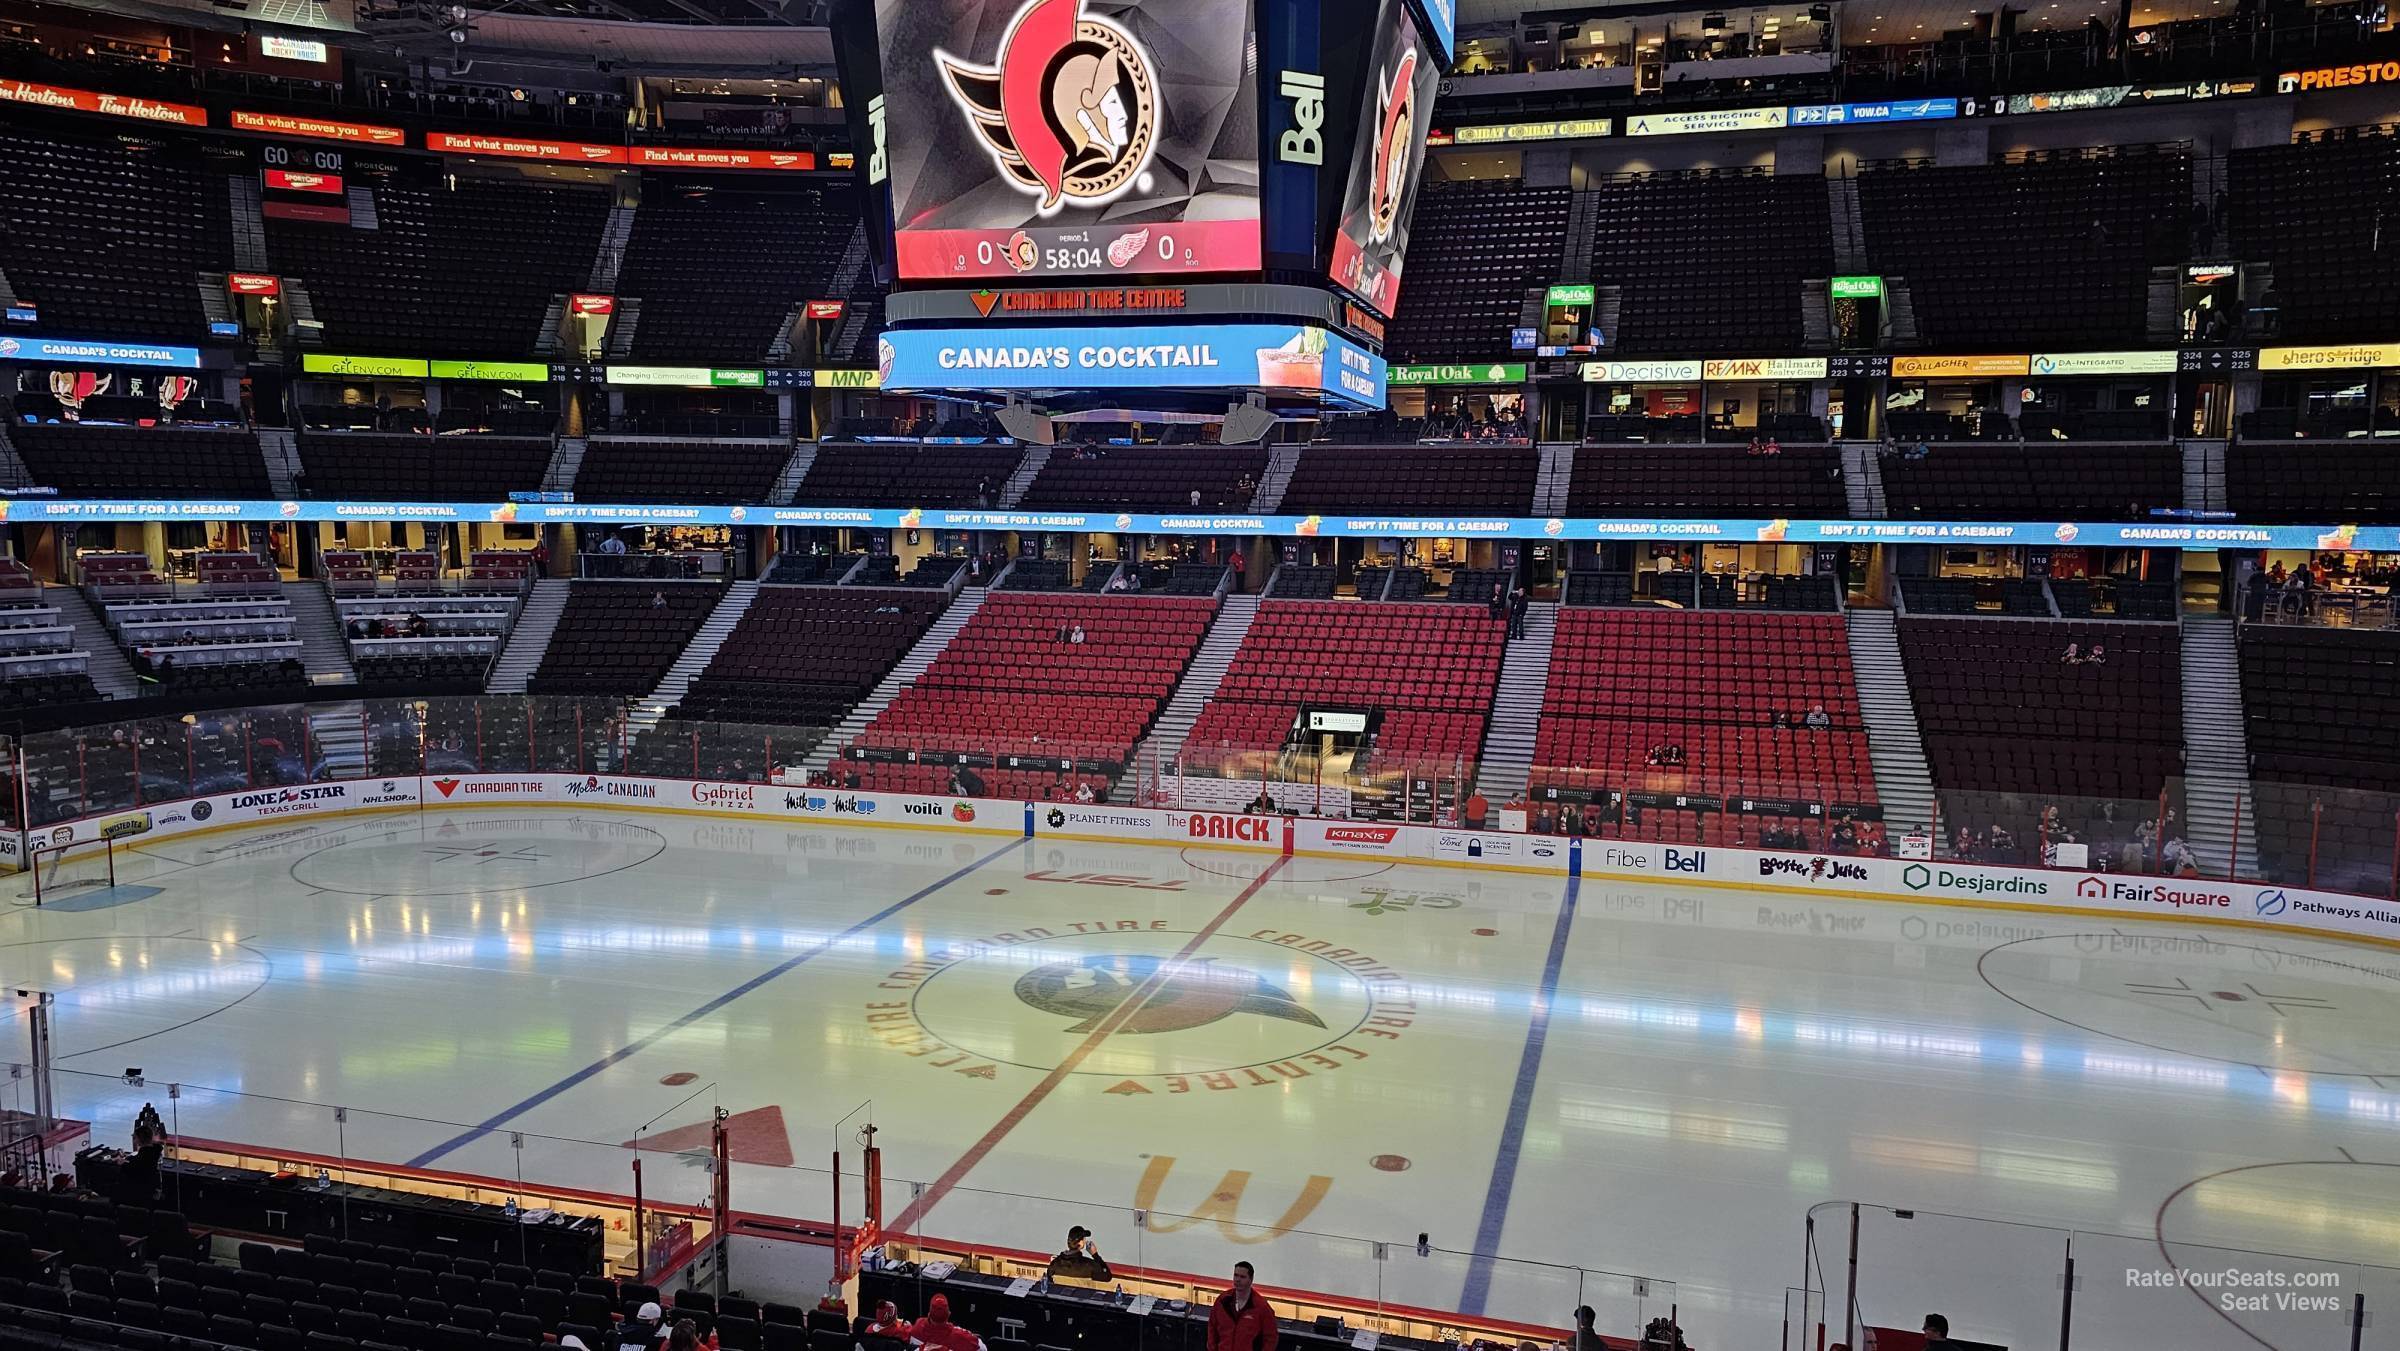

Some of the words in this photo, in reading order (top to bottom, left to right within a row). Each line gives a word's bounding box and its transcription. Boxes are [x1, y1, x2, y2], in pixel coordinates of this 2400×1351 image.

[15, 83, 77, 107] Hortons
[97, 95, 127, 116] Tim
[128, 100, 187, 122] Hortons
[1852, 106, 1890, 118] YOW.CA
[1965, 101, 1976, 115] 0
[1994, 100, 2005, 114] 0
[1281, 70, 1325, 166] Bell
[1663, 114, 1706, 123] ACCESS
[1710, 111, 1761, 121] RIGGING
[236, 114, 263, 127] Find
[266, 116, 298, 129] what
[299, 121, 336, 134] moves
[338, 124, 360, 138] you
[1457, 126, 1505, 141] COMBAT
[1507, 124, 1557, 138] COMBAT
[1558, 121, 1609, 136] COMBAT
[1684, 120, 1738, 130] SERVICES
[445, 136, 471, 148] Find
[473, 138, 501, 149] what
[503, 142, 536, 152] moves
[539, 143, 560, 156] you
[869, 94, 887, 185] Bell
[264, 146, 288, 164] GO
[315, 151, 342, 170] GO!
[644, 151, 669, 161] Find
[671, 151, 696, 162] what
[697, 153, 729, 163] moves
[731, 154, 749, 165] you
[978, 241, 992, 265] 0
[1158, 235, 1174, 260] 0
[1185, 248, 1192, 259] 0
[958, 255, 965, 265] 0
[1045, 247, 1102, 270] 58:04
[1003, 290, 1086, 310] CANADIAN
[1087, 289, 1124, 310] TIRE
[1126, 288, 1186, 309] CENTRE
[1573, 289, 1591, 299] Oak
[42, 344, 107, 357] CANADA'S
[109, 346, 173, 360] COCKTAIL
[938, 345, 1070, 370] CANADA'S
[1077, 344, 1219, 369] COCKTAIL
[2183, 351, 2202, 360] 324
[2231, 350, 2251, 359] 325
[1767, 359, 1823, 370] Hallmark
[1831, 358, 1849, 366] 323
[1871, 357, 1888, 365] 324
[1907, 359, 1969, 372] GALLAGHER
[2058, 359, 2125, 367] DA-INTEGRATED
[2183, 362, 2201, 370] 224
[2231, 360, 2250, 369] 225
[616, 371, 651, 380] Changing
[652, 372, 699, 380] Communities
[1396, 366, 1438, 384] Royal
[1441, 365, 1473, 380] Oak
[1610, 363, 1692, 380] Decisive
[1706, 361, 1763, 377] RE/MAX
[1767, 369, 1796, 378] Realty
[1797, 368, 1824, 377] Group
[1831, 369, 1848, 377] 223
[1870, 369, 1887, 377] 224
[552, 374, 566, 382] 218
[798, 379, 811, 387] 220
[831, 371, 873, 386] MNP
[46, 504, 76, 515] ISN'T
[85, 505, 98, 515] IT
[103, 505, 135, 515] TIME
[138, 505, 162, 515] FOR
[165, 505, 179, 515] A
[185, 505, 241, 516] CAESAR?
[337, 505, 398, 516] CANADA'S
[400, 506, 457, 516] COCKTAIL
[545, 507, 573, 517] ISN'T
[577, 508, 588, 517] IT
[591, 508, 616, 517] TIME
[618, 508, 639, 518] FOR
[640, 509, 652, 518] A
[654, 509, 700, 518] CAESAR?
[774, 511, 821, 520] CANADA'S
[824, 512, 872, 521] COCKTAIL
[945, 515, 970, 524] ISN'T
[972, 515, 983, 524] IT
[984, 515, 1009, 525] TIME
[1011, 516, 1030, 525] FOR
[1031, 516, 1039, 525] A
[1041, 516, 1085, 526] CAESAR?
[1161, 519, 1211, 528] CANADA'S
[1213, 520, 1264, 529] COCKTAIL
[1347, 521, 1375, 530] ISN'T
[1378, 522, 1389, 531] IT
[1391, 522, 1418, 531] TIME
[1421, 522, 1446, 531] FOR
[1447, 522, 1455, 531] A
[1457, 522, 1510, 532] CAESAR?
[1598, 524, 1658, 534] CANADA'S
[1660, 524, 1721, 534] COCKTAIL
[1820, 525, 1855, 535] ISN'T
[1857, 526, 1870, 536] IT
[1874, 526, 1906, 536] TIME
[1908, 526, 1935, 536] FOR
[1939, 526, 1949, 536] A
[1952, 526, 2014, 537] CAESAR?
[2120, 528, 2192, 541] CANADA'S
[2195, 529, 2271, 541] COCKTAIL
[2031, 556, 2047, 564] 118
[464, 782, 520, 794] CANADIAN
[521, 782, 544, 793] TIRE
[565, 776, 604, 797] Molson
[607, 782, 656, 799] CANADIAN
[692, 783, 754, 803] Gabriel
[231, 791, 277, 809] LONE
[300, 785, 346, 800] STAR
[711, 799, 754, 809] PIZZA
[257, 804, 290, 815] TEXAS
[292, 802, 319, 812] GRILL
[904, 801, 943, 816] voilà
[1069, 813, 1108, 825] PLANET
[1110, 815, 1151, 827] FITNESS
[104, 821, 130, 836] TWISTED
[131, 821, 143, 830] TEA
[1165, 813, 1187, 828] The
[1189, 813, 1271, 842] BRICK
[1440, 836, 1463, 848] Ford
[1606, 849, 1647, 868] Fibe
[1664, 849, 1705, 873] Bell
[1759, 857, 1810, 877] Booster
[1826, 861, 1868, 881] Juice
[1938, 871, 2048, 895] Desjardins
[2113, 883, 2231, 908] FairSquare
[2293, 900, 2361, 919] Pathways
[1066, 919, 1170, 934] TIRE
[1356, 1000, 1417, 1040] TIRE
[1163, 1045, 1369, 1094] CENTRE
